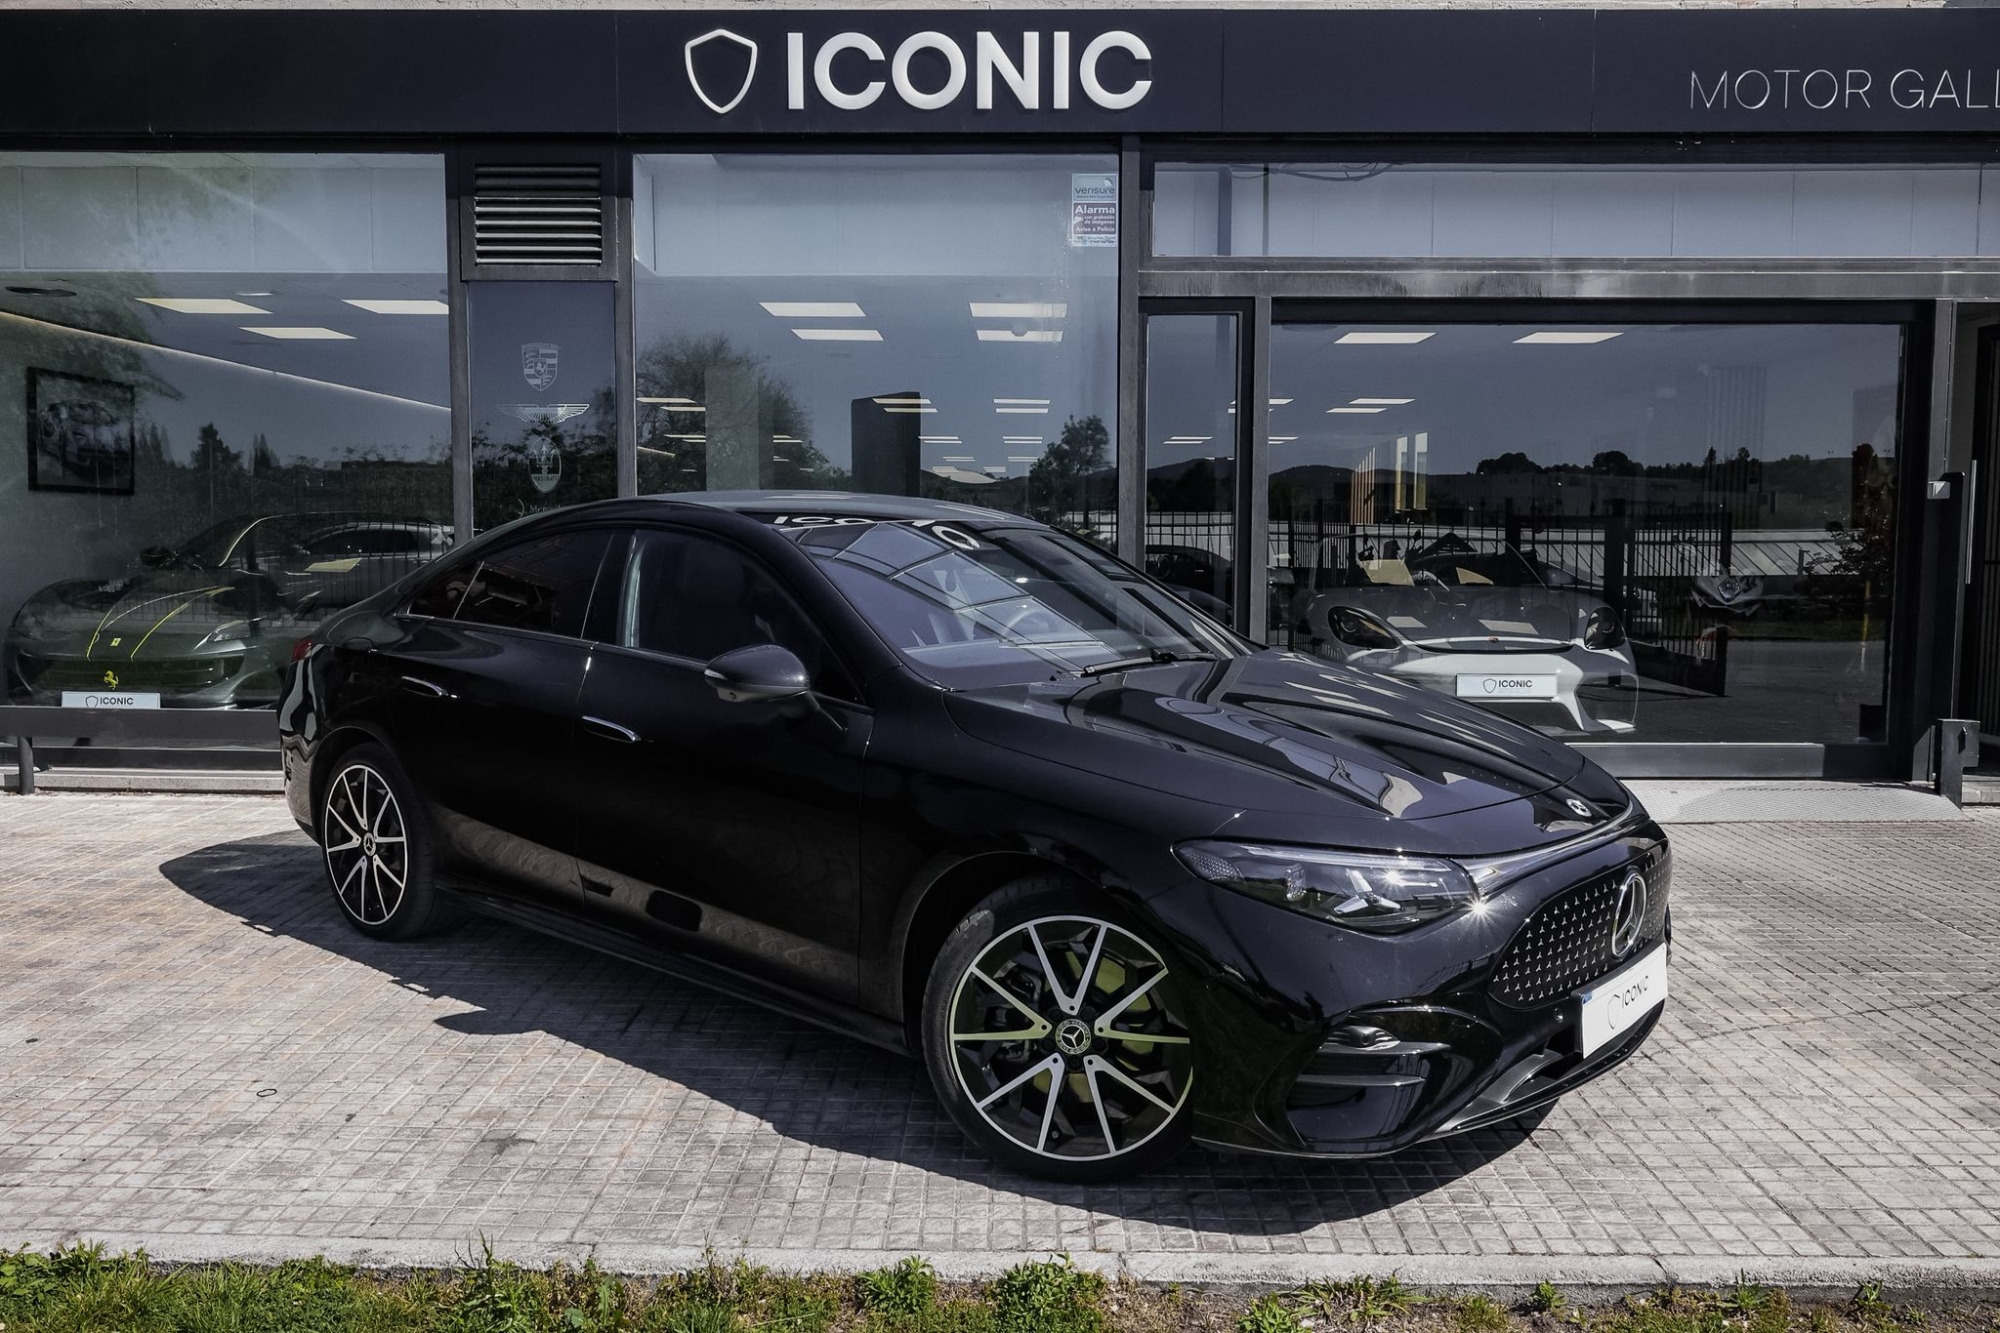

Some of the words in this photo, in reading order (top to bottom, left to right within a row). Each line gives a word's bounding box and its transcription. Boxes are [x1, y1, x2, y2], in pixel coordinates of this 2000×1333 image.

[787, 30, 1153, 110] ICONIC
[1690, 69, 1873, 109] MOTOR
[1890, 68, 2000, 109] GAL
[1075, 187, 1115, 195] verisure
[1075, 204, 1115, 214] Alarma
[1498, 679, 1533, 688] ICONIC
[100, 697, 134, 705] ICONIC
